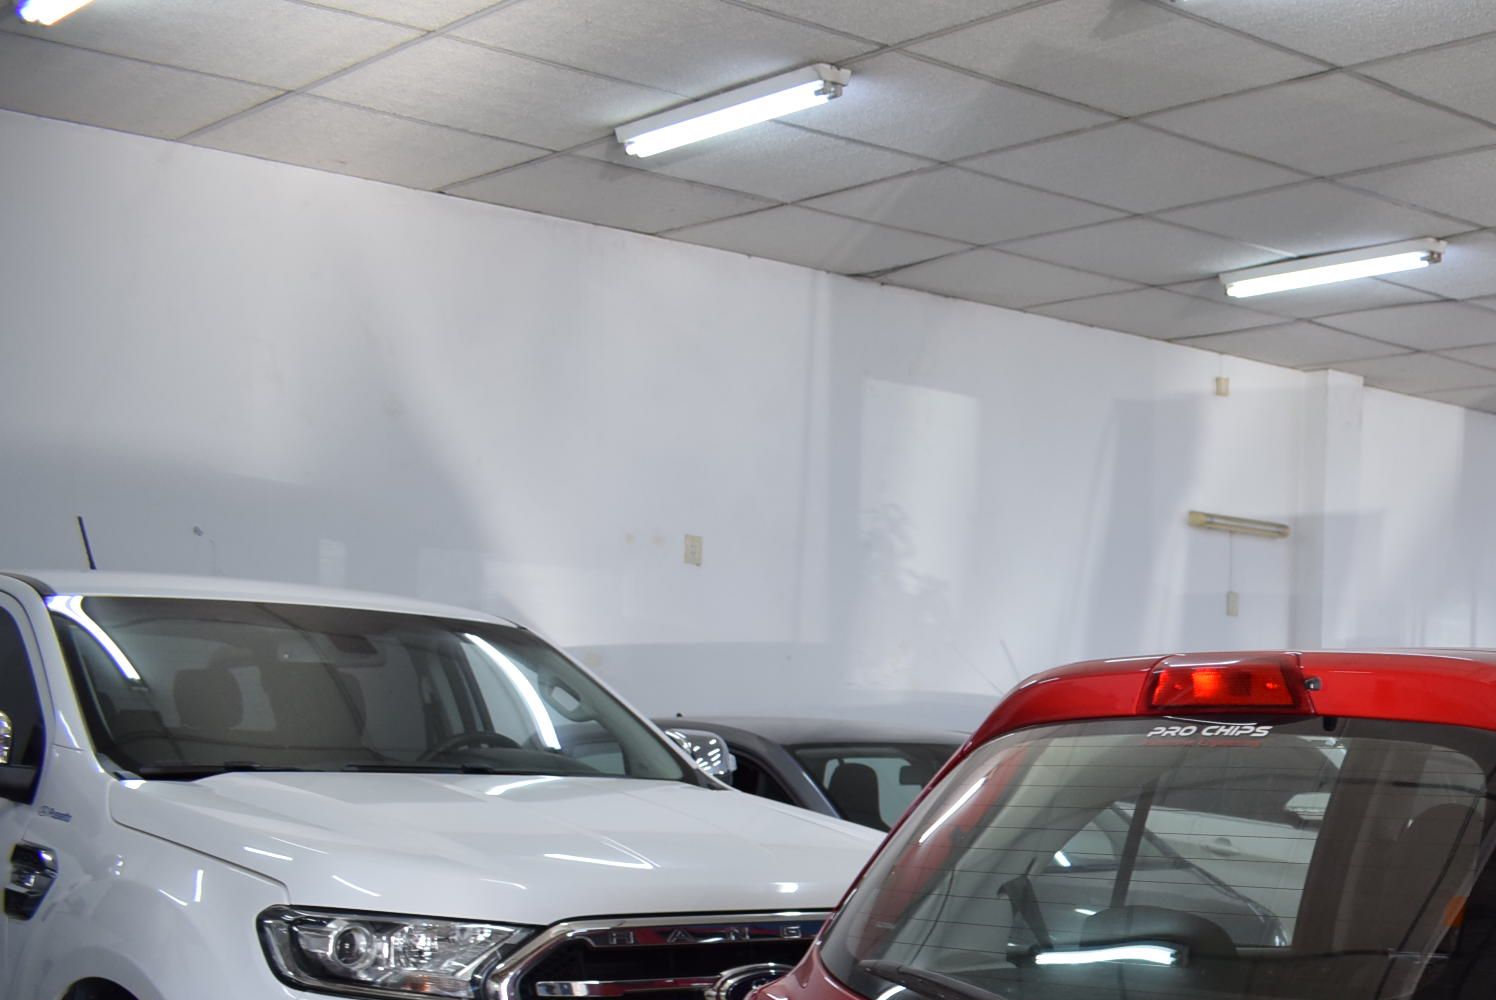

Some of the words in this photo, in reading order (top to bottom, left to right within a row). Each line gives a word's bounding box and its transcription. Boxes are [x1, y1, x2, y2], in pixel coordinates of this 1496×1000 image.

[1145, 725, 1199, 737] PRO
[1201, 725, 1273, 737] CHIPS
[609, 925, 802, 945] RANG
